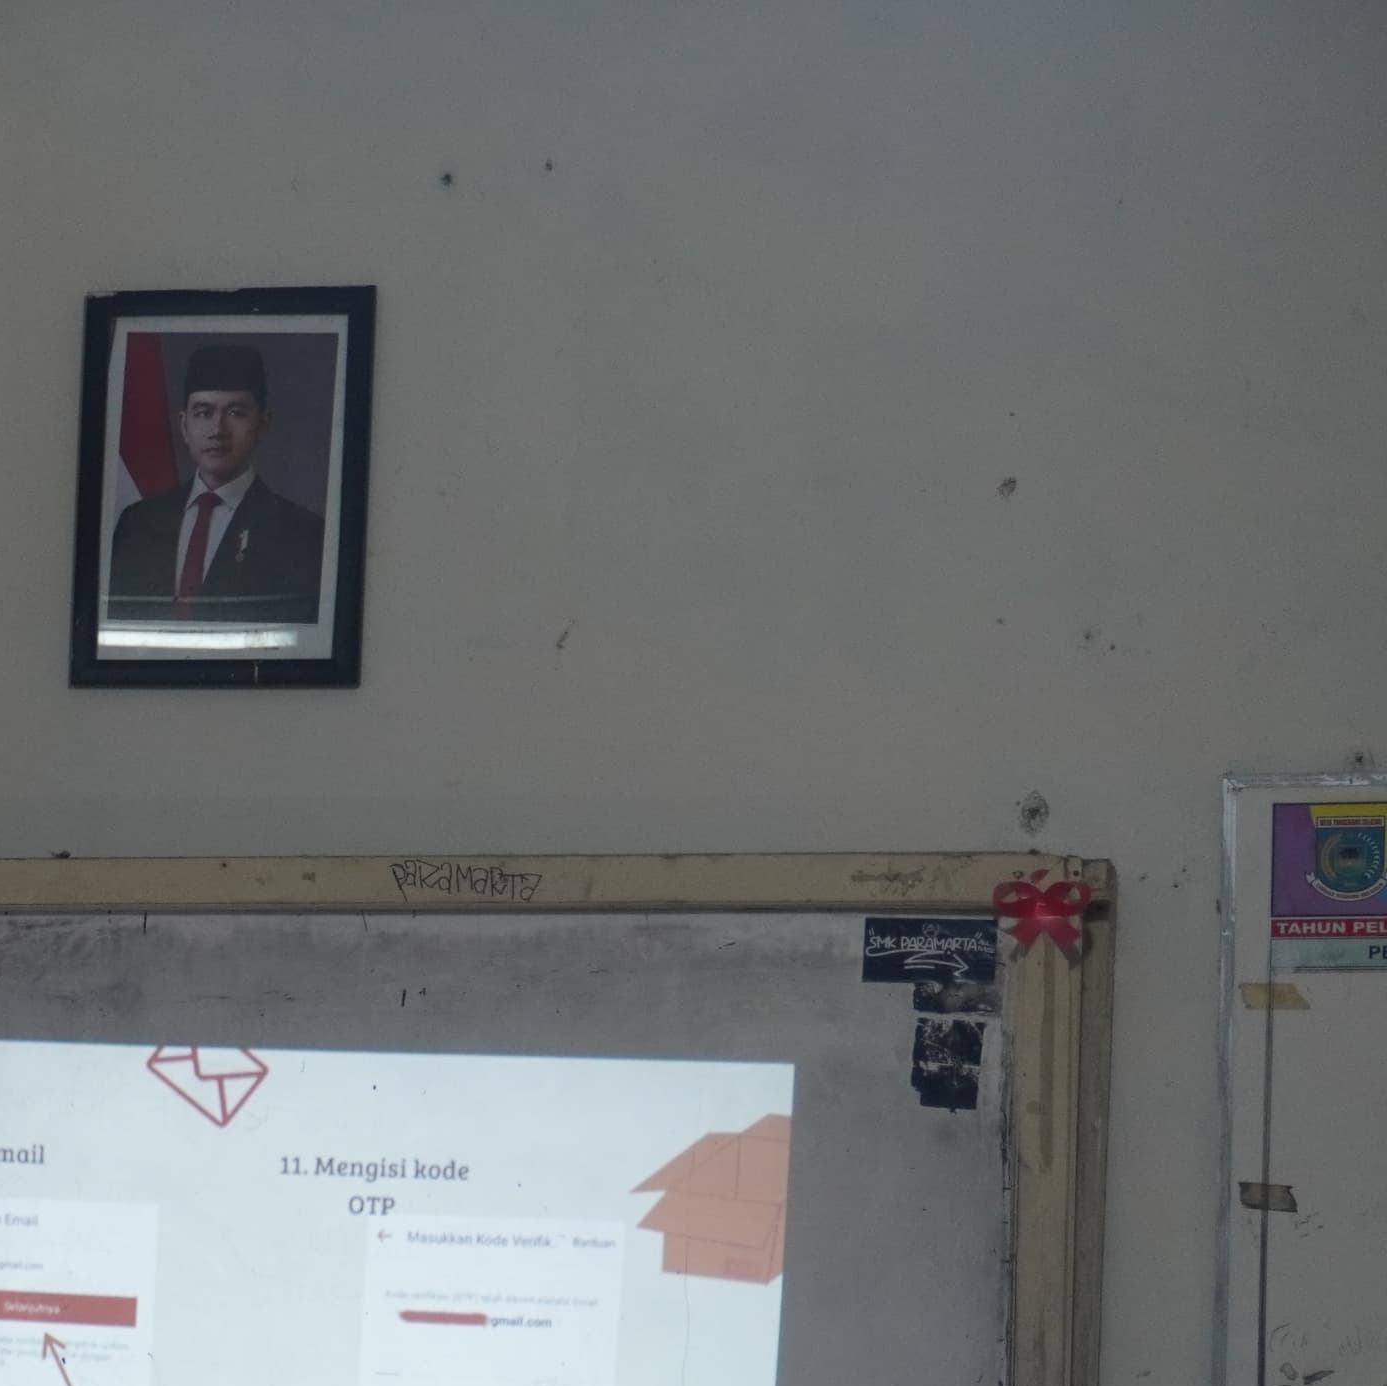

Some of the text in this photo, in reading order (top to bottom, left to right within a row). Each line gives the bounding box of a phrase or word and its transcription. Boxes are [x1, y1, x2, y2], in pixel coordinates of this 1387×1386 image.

[1275, 920, 1347, 935] TAHUN
[279, 1155, 471, 1183] 11. Mengisi kode
[347, 1194, 397, 1216] OTP
[4, 1212, 39, 1227] Email
[407, 1230, 473, 1246] Masukkan
[475, 1233, 510, 1248] Kode
